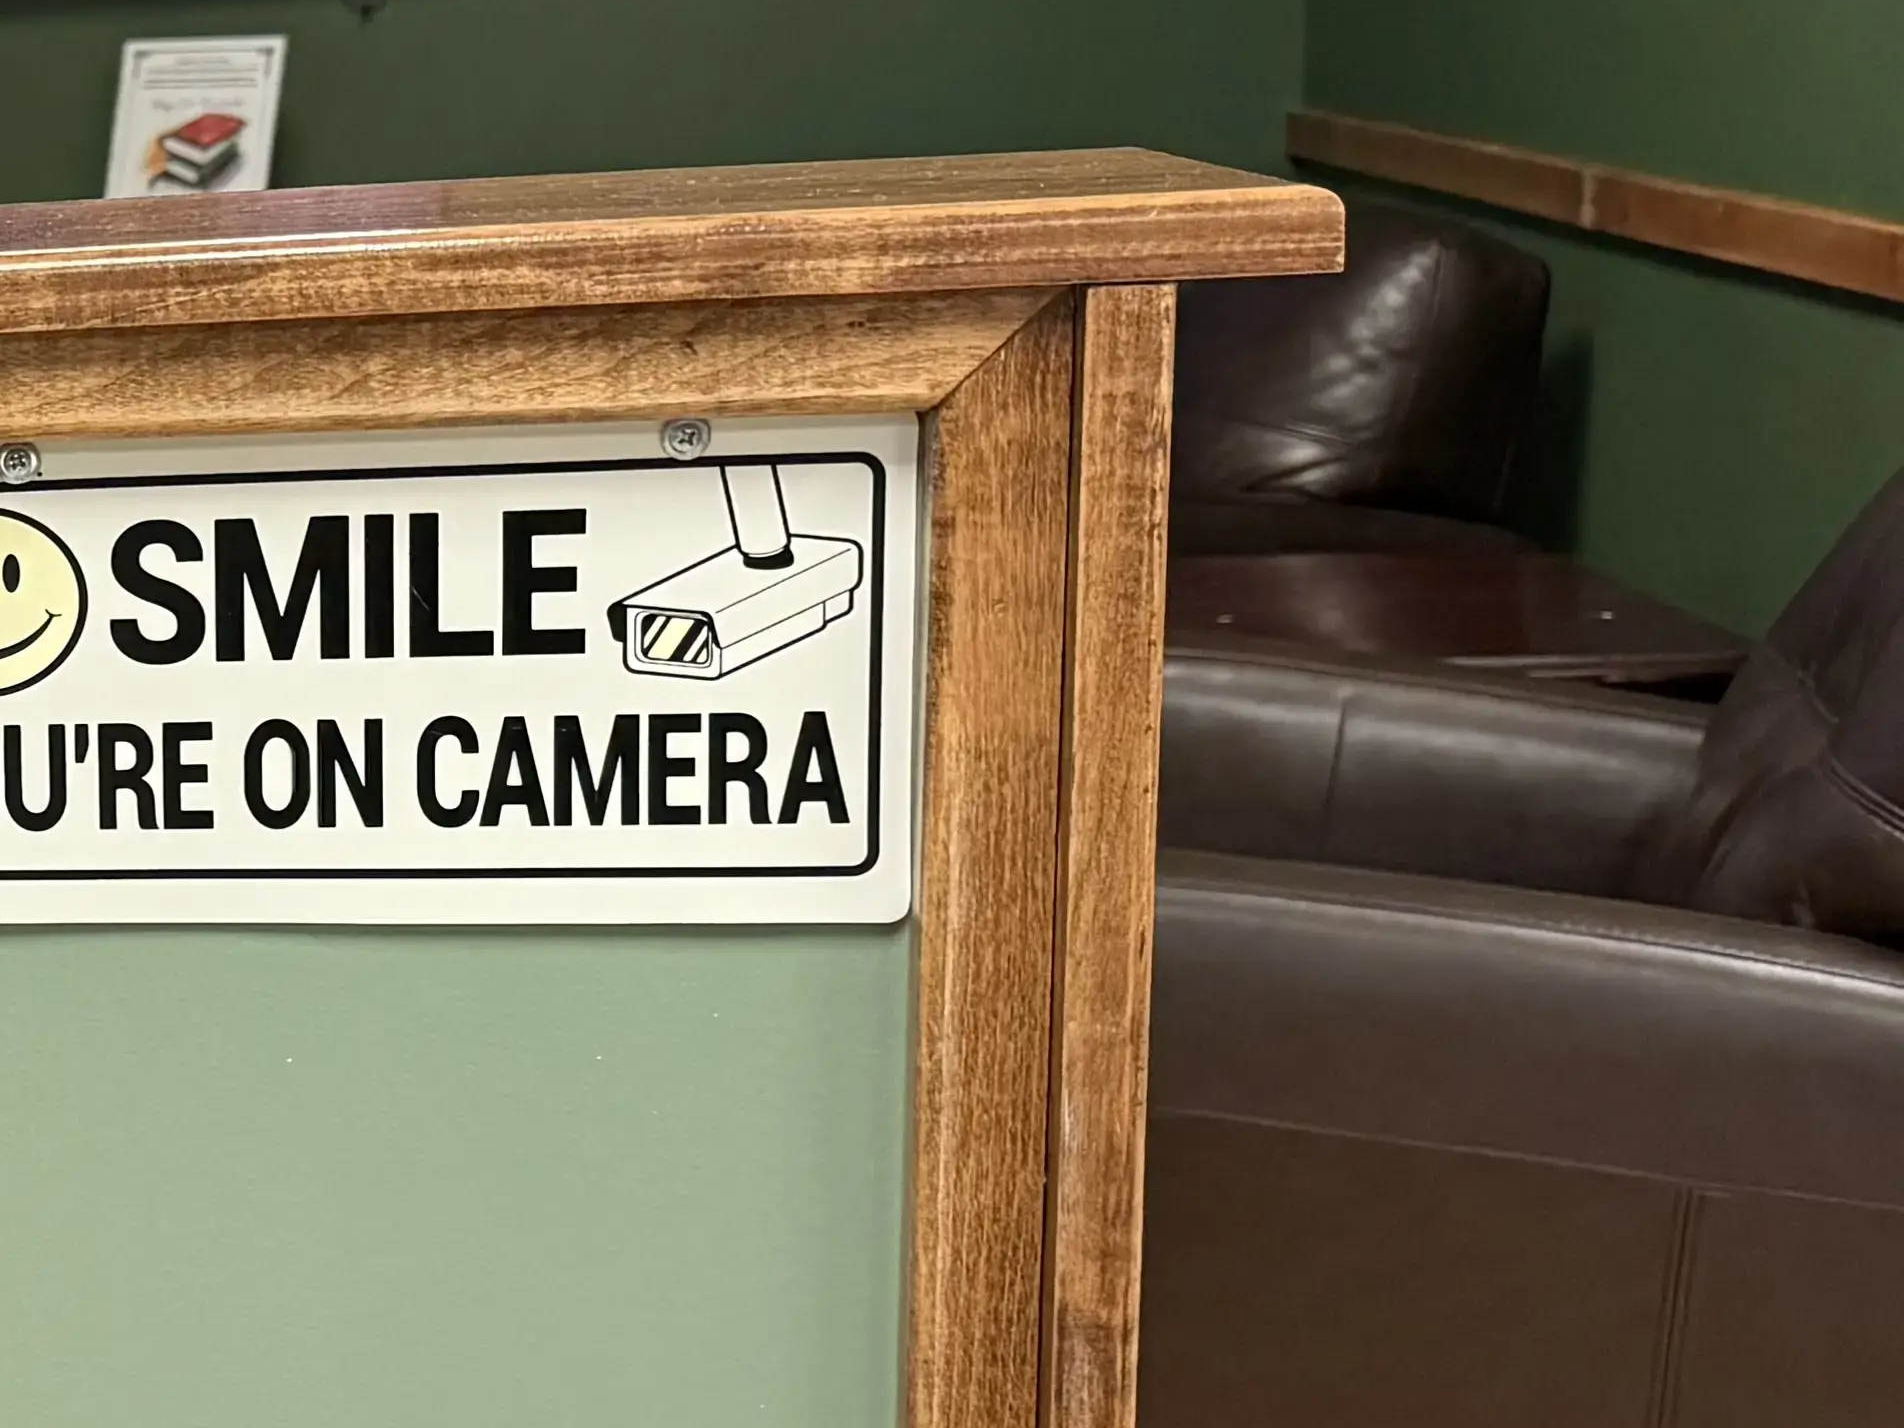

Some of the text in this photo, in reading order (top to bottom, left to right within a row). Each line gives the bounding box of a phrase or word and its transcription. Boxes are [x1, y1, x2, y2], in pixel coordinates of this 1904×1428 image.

[109, 508, 587, 665] SMILE
[243, 718, 384, 829] ON
[417, 710, 850, 828] CAMERA
